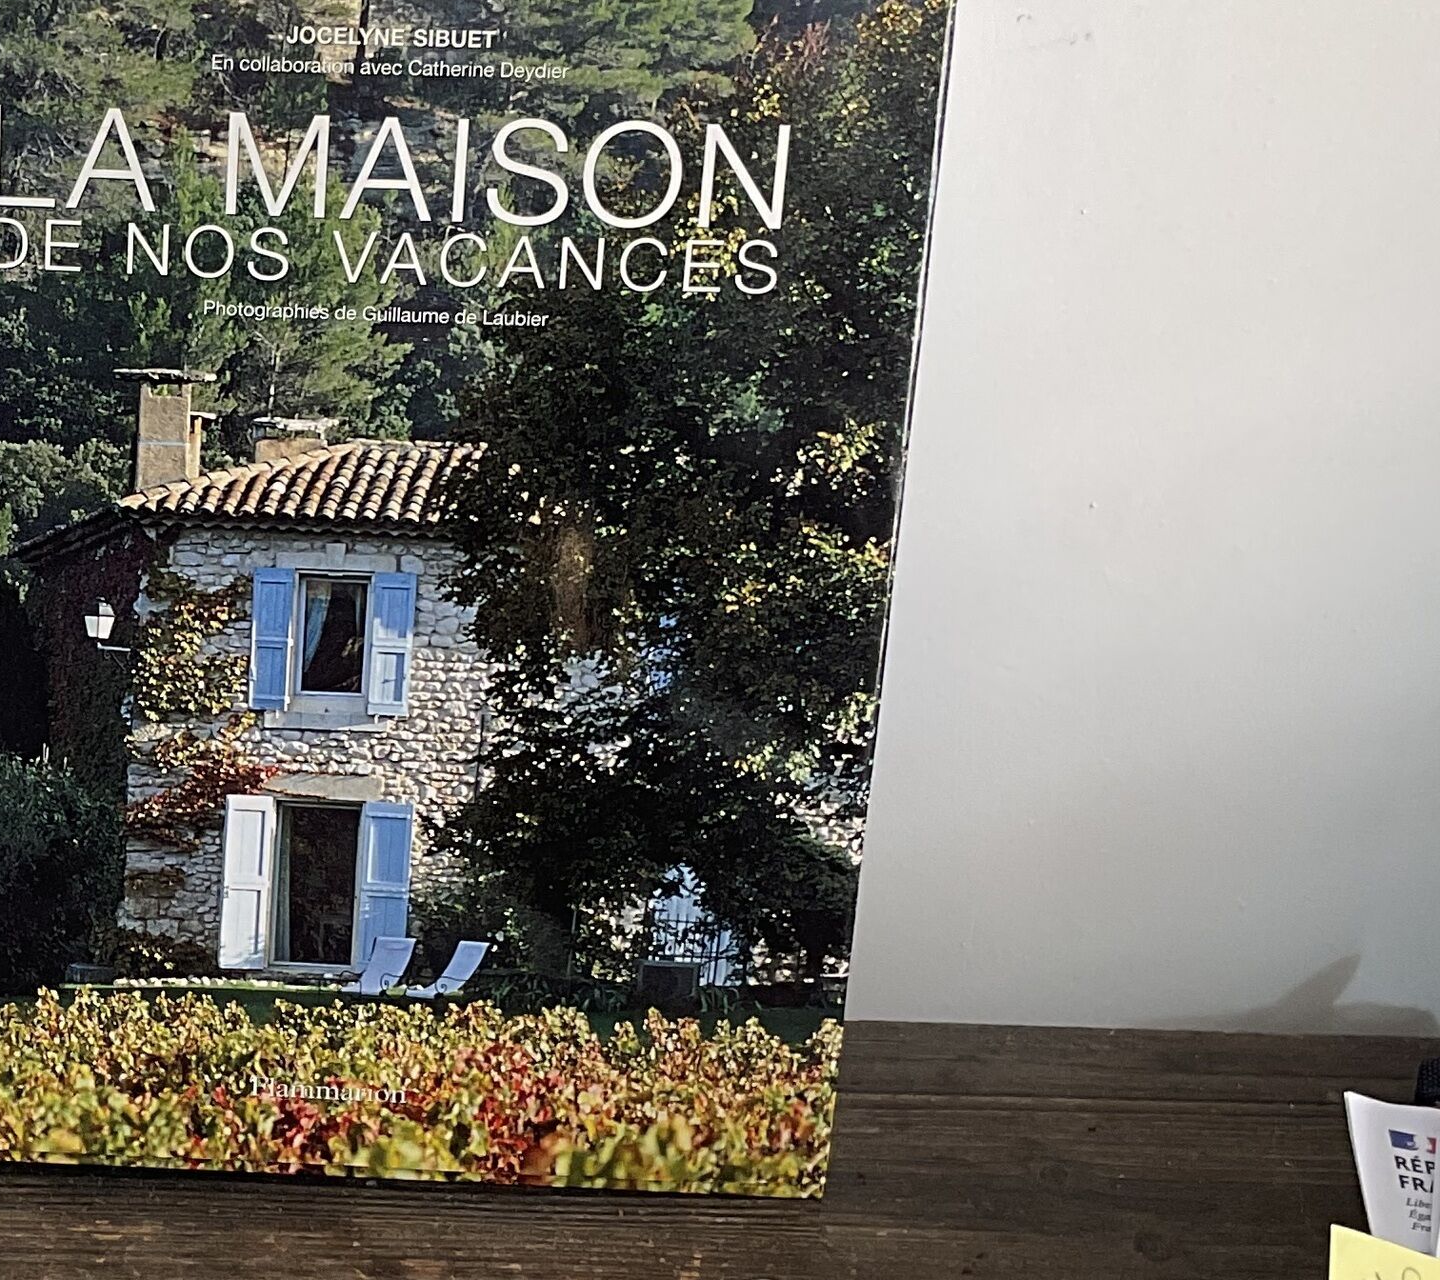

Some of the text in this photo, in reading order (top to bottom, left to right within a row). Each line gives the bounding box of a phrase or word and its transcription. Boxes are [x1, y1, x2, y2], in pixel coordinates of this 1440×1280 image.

[285, 25, 497, 49] JOCELYNE SIBUET
[211, 53, 570, 83] En collaboration avec Catherine Deydier
[223, 111, 792, 232] MAISON
[126, 223, 291, 282] NOS
[332, 229, 780, 296] VACANCES
[203, 299, 550, 328] Photographies de Guillaume de Laubier
[249, 1074, 407, 1105] Flammarion
